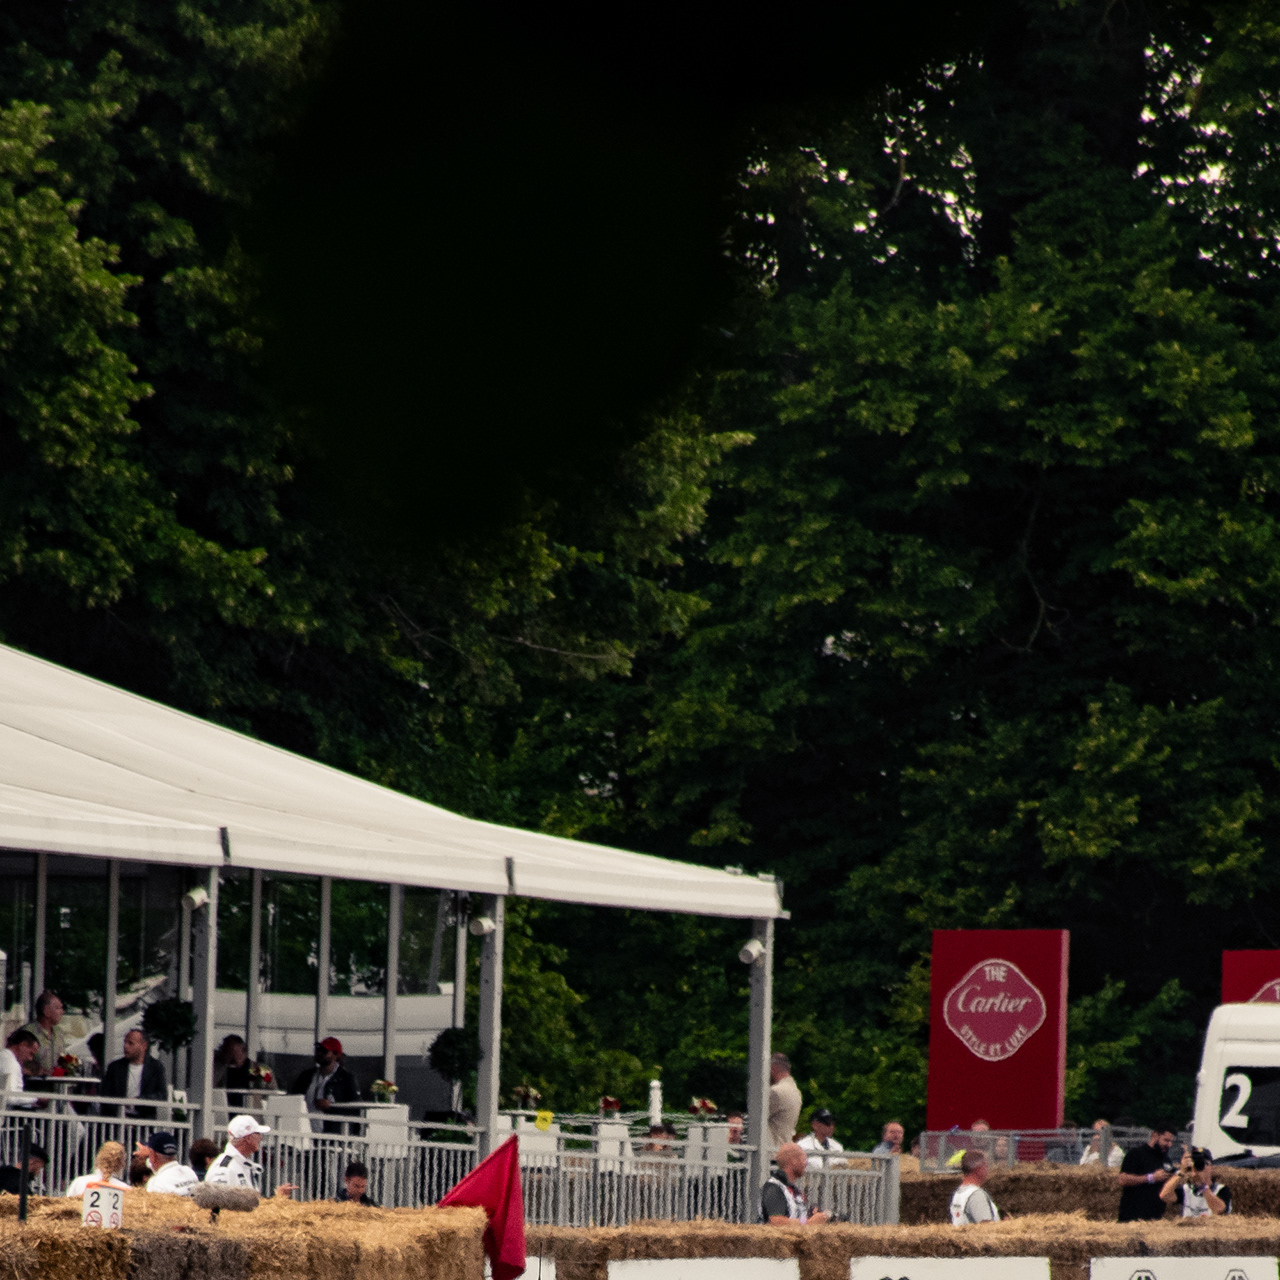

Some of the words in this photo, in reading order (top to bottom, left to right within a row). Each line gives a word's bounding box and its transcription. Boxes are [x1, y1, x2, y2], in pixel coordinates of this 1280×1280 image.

[984, 966, 1008, 983] THE
[957, 984, 1032, 1014] Cartier
[1220, 1072, 1252, 1129] 2
[90, 1190, 100, 1208] 2
[112, 1192, 119, 1210] 2
